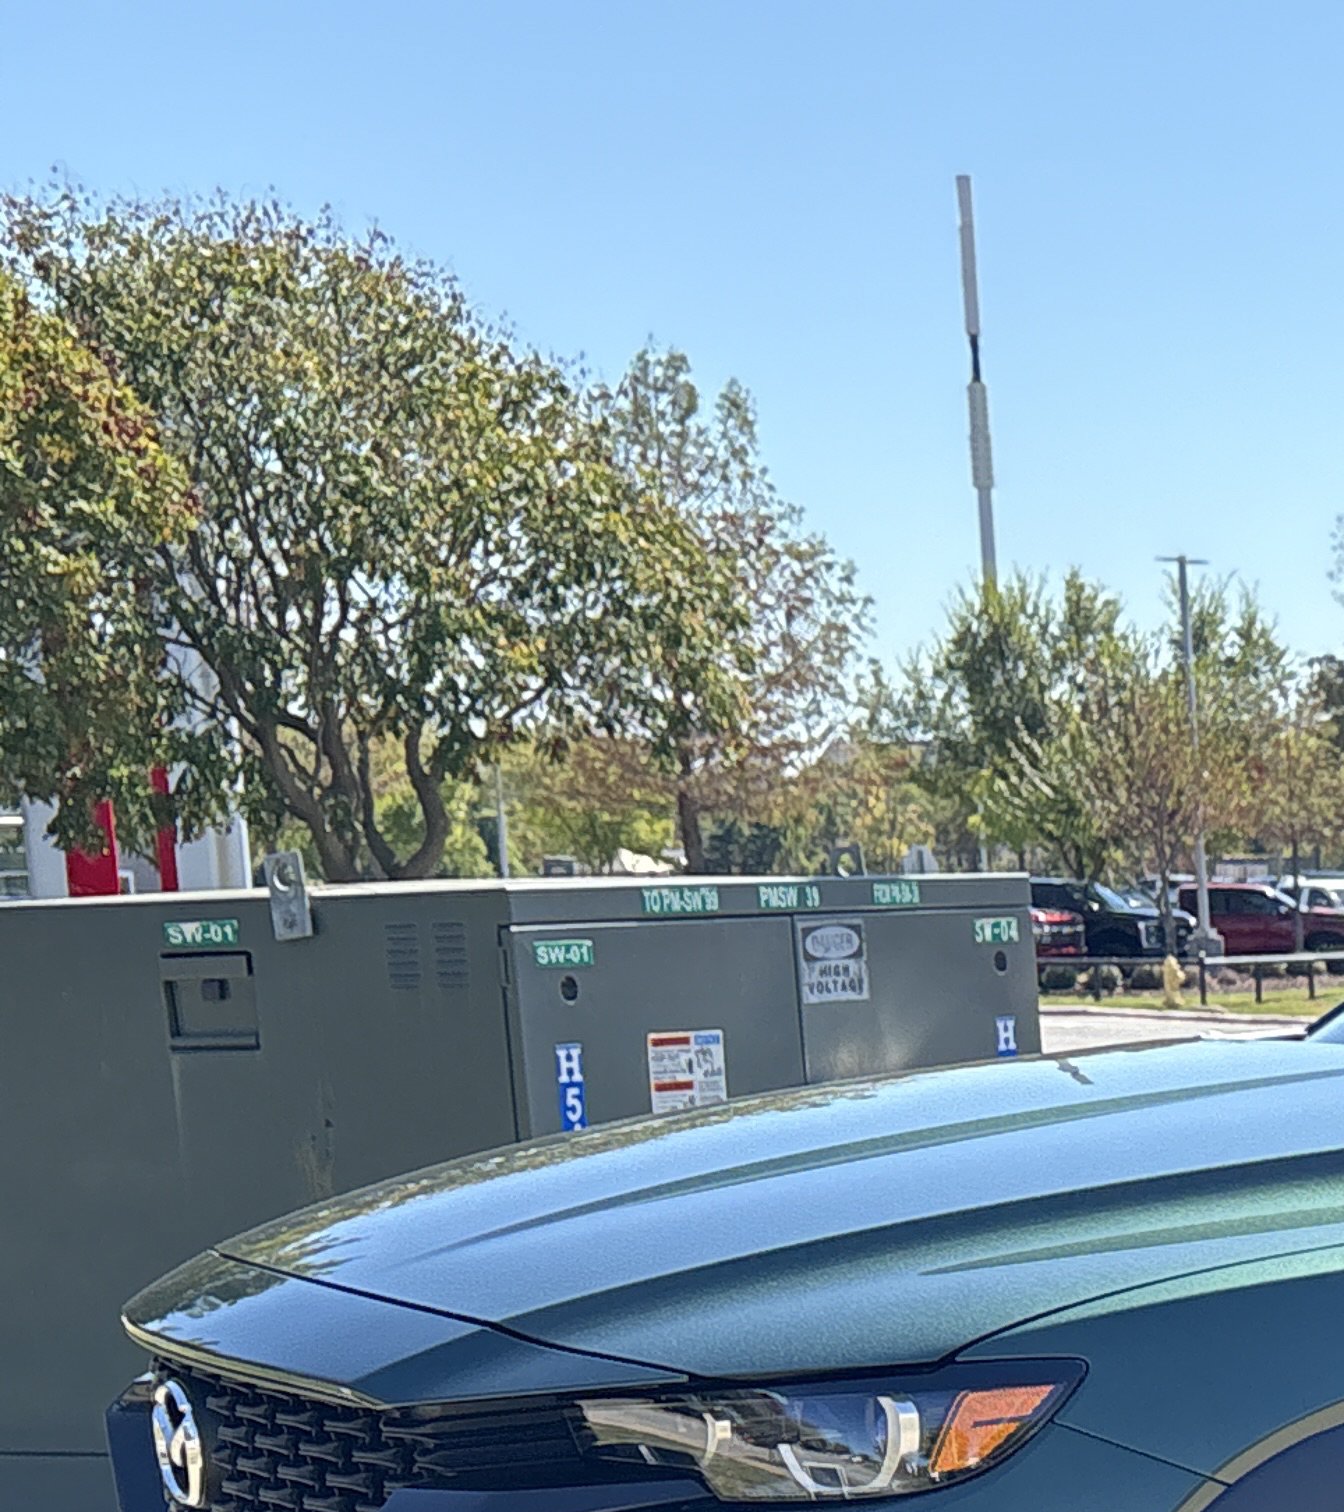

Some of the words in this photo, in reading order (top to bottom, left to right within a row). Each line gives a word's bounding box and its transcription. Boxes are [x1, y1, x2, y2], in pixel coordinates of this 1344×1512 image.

[166, 924, 235, 945] SW-01
[975, 918, 1019, 944] SW-04
[536, 945, 589, 966] SW-01
[996, 1019, 1017, 1050] H
